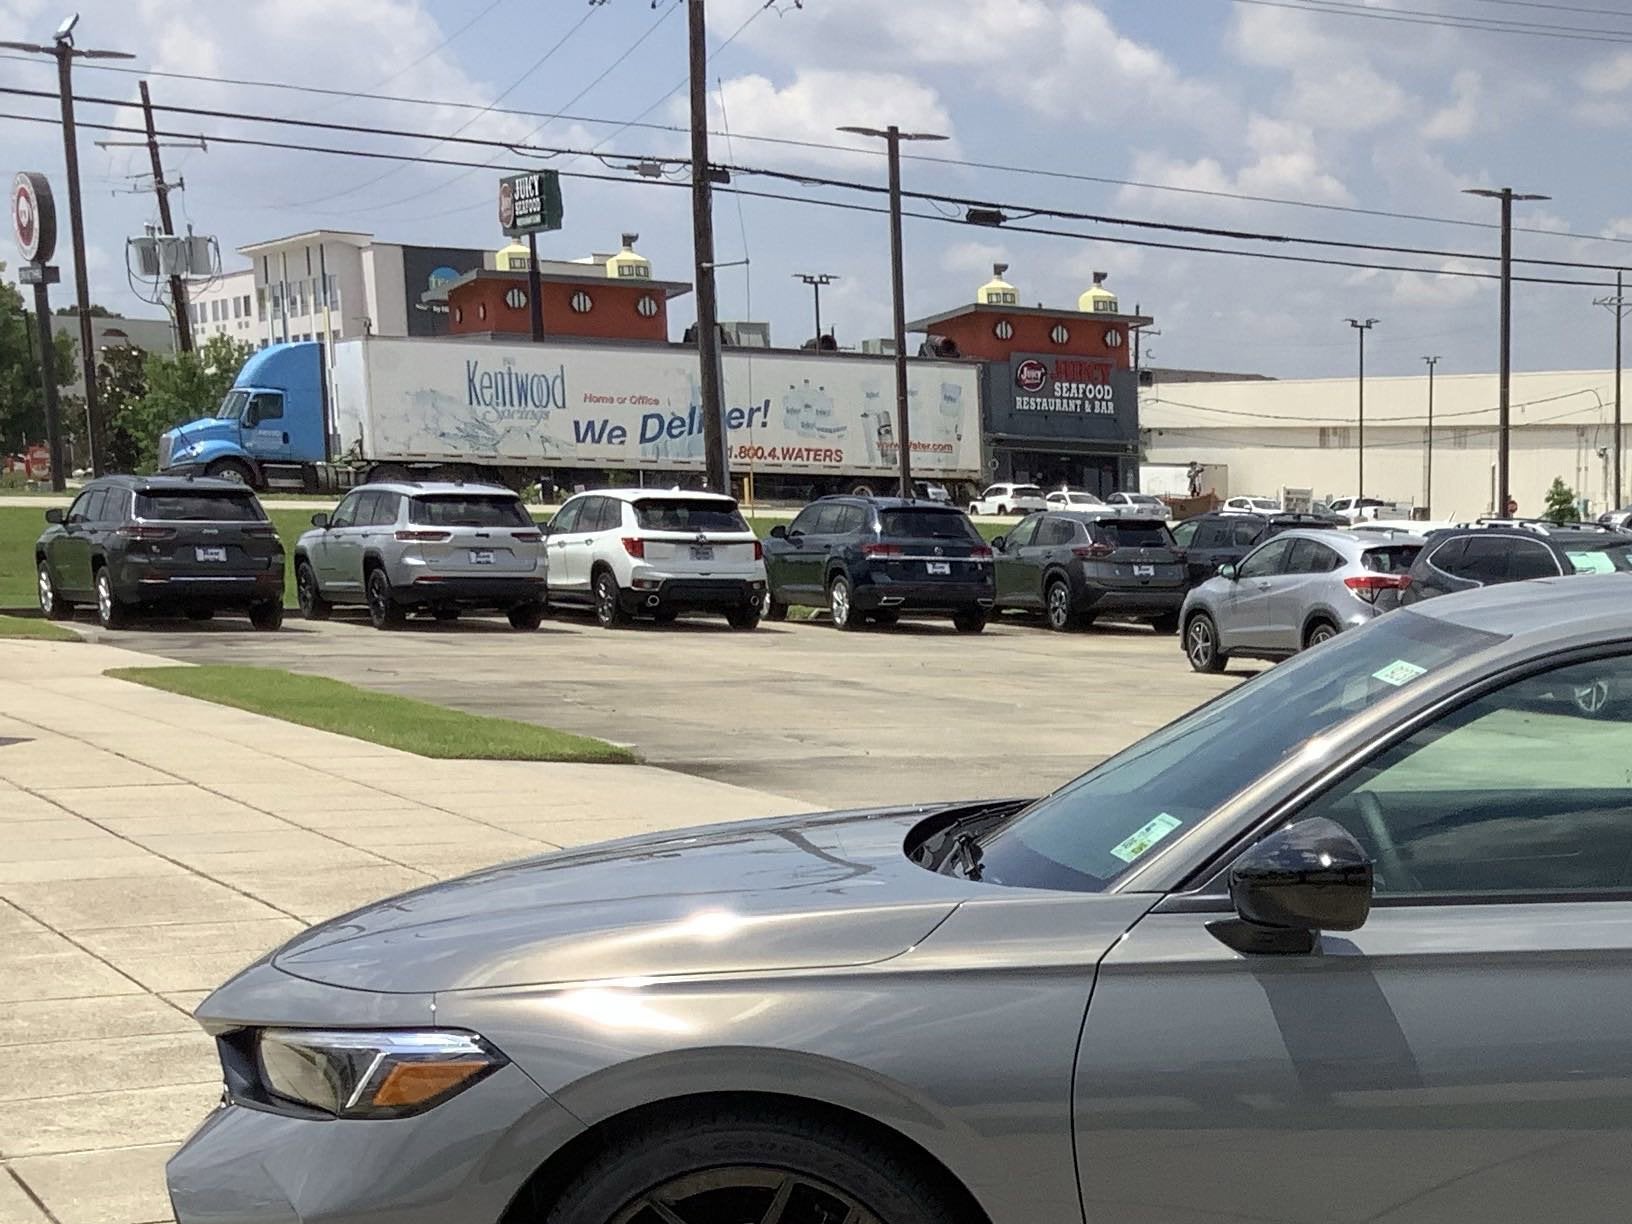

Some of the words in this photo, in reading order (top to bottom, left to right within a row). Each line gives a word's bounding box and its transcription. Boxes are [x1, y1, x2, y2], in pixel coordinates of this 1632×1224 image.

[514, 175, 539, 200] JUICY
[466, 360, 567, 409] Kentwood
[1054, 382, 1113, 399] SEAFOOD
[583, 392, 615, 405] Home
[616, 396, 627, 405] or
[629, 394, 660, 406] Office
[1016, 397, 1082, 412] RESTAURANT
[1084, 400, 1092, 412] &
[1094, 401, 1114, 414] BAR
[573, 418, 628, 445] We
[639, 399, 771, 445] Delier!
